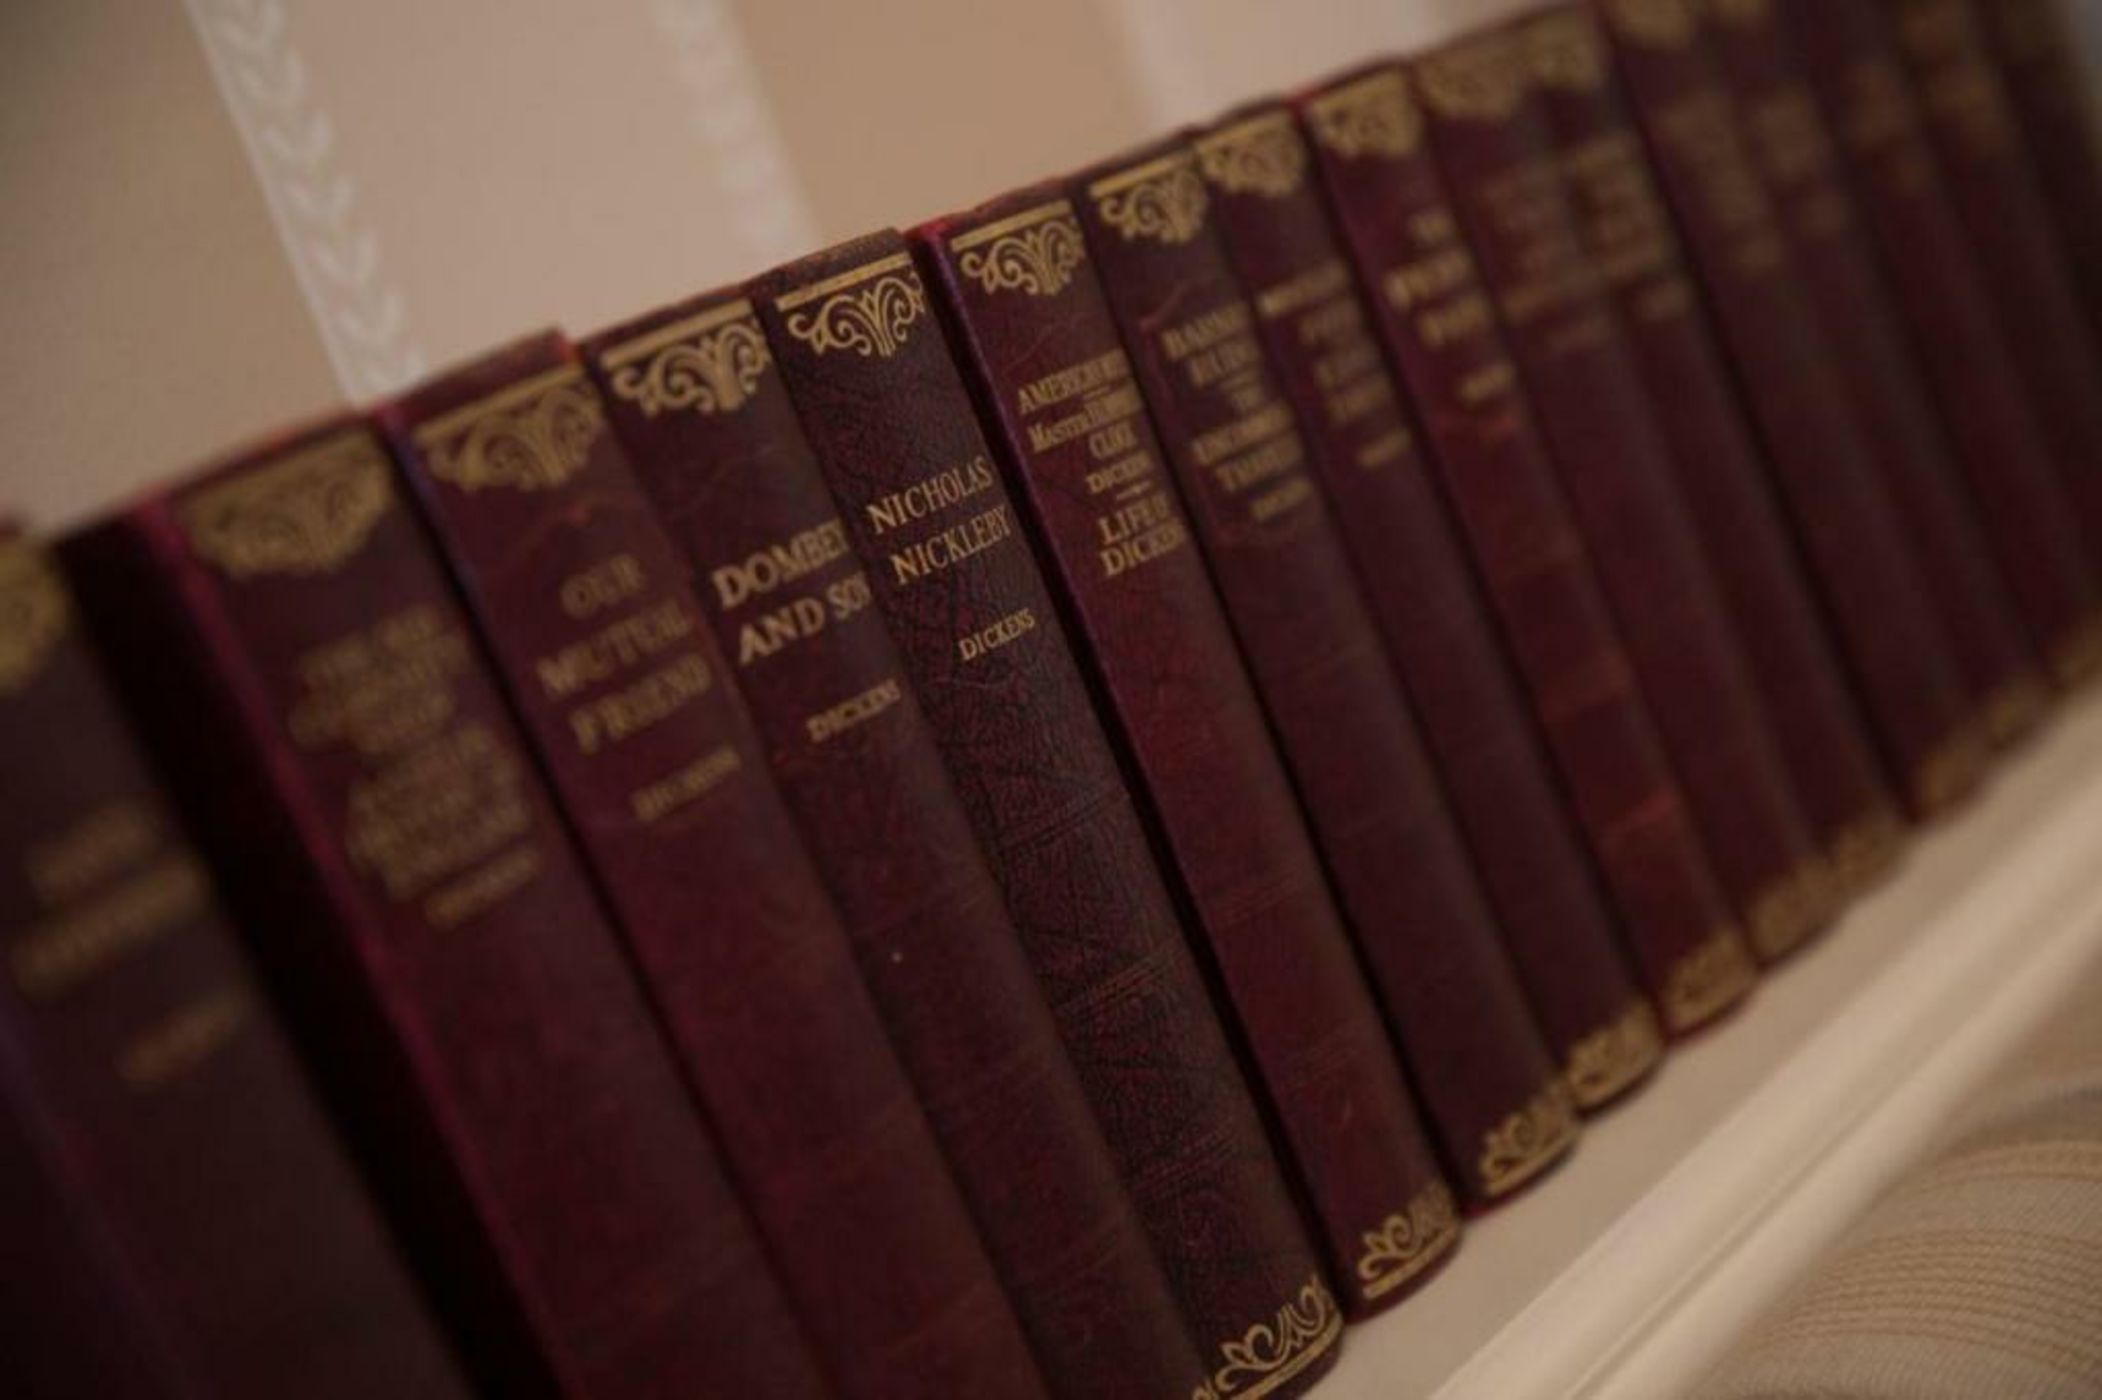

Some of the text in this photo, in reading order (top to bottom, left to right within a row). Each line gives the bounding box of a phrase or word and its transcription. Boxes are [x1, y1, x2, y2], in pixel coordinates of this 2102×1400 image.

[866, 455, 993, 535] NICHOLAS
[889, 503, 1011, 586] NICKLEBY
[738, 597, 826, 666] AND
[958, 607, 1036, 661] DICKENS
